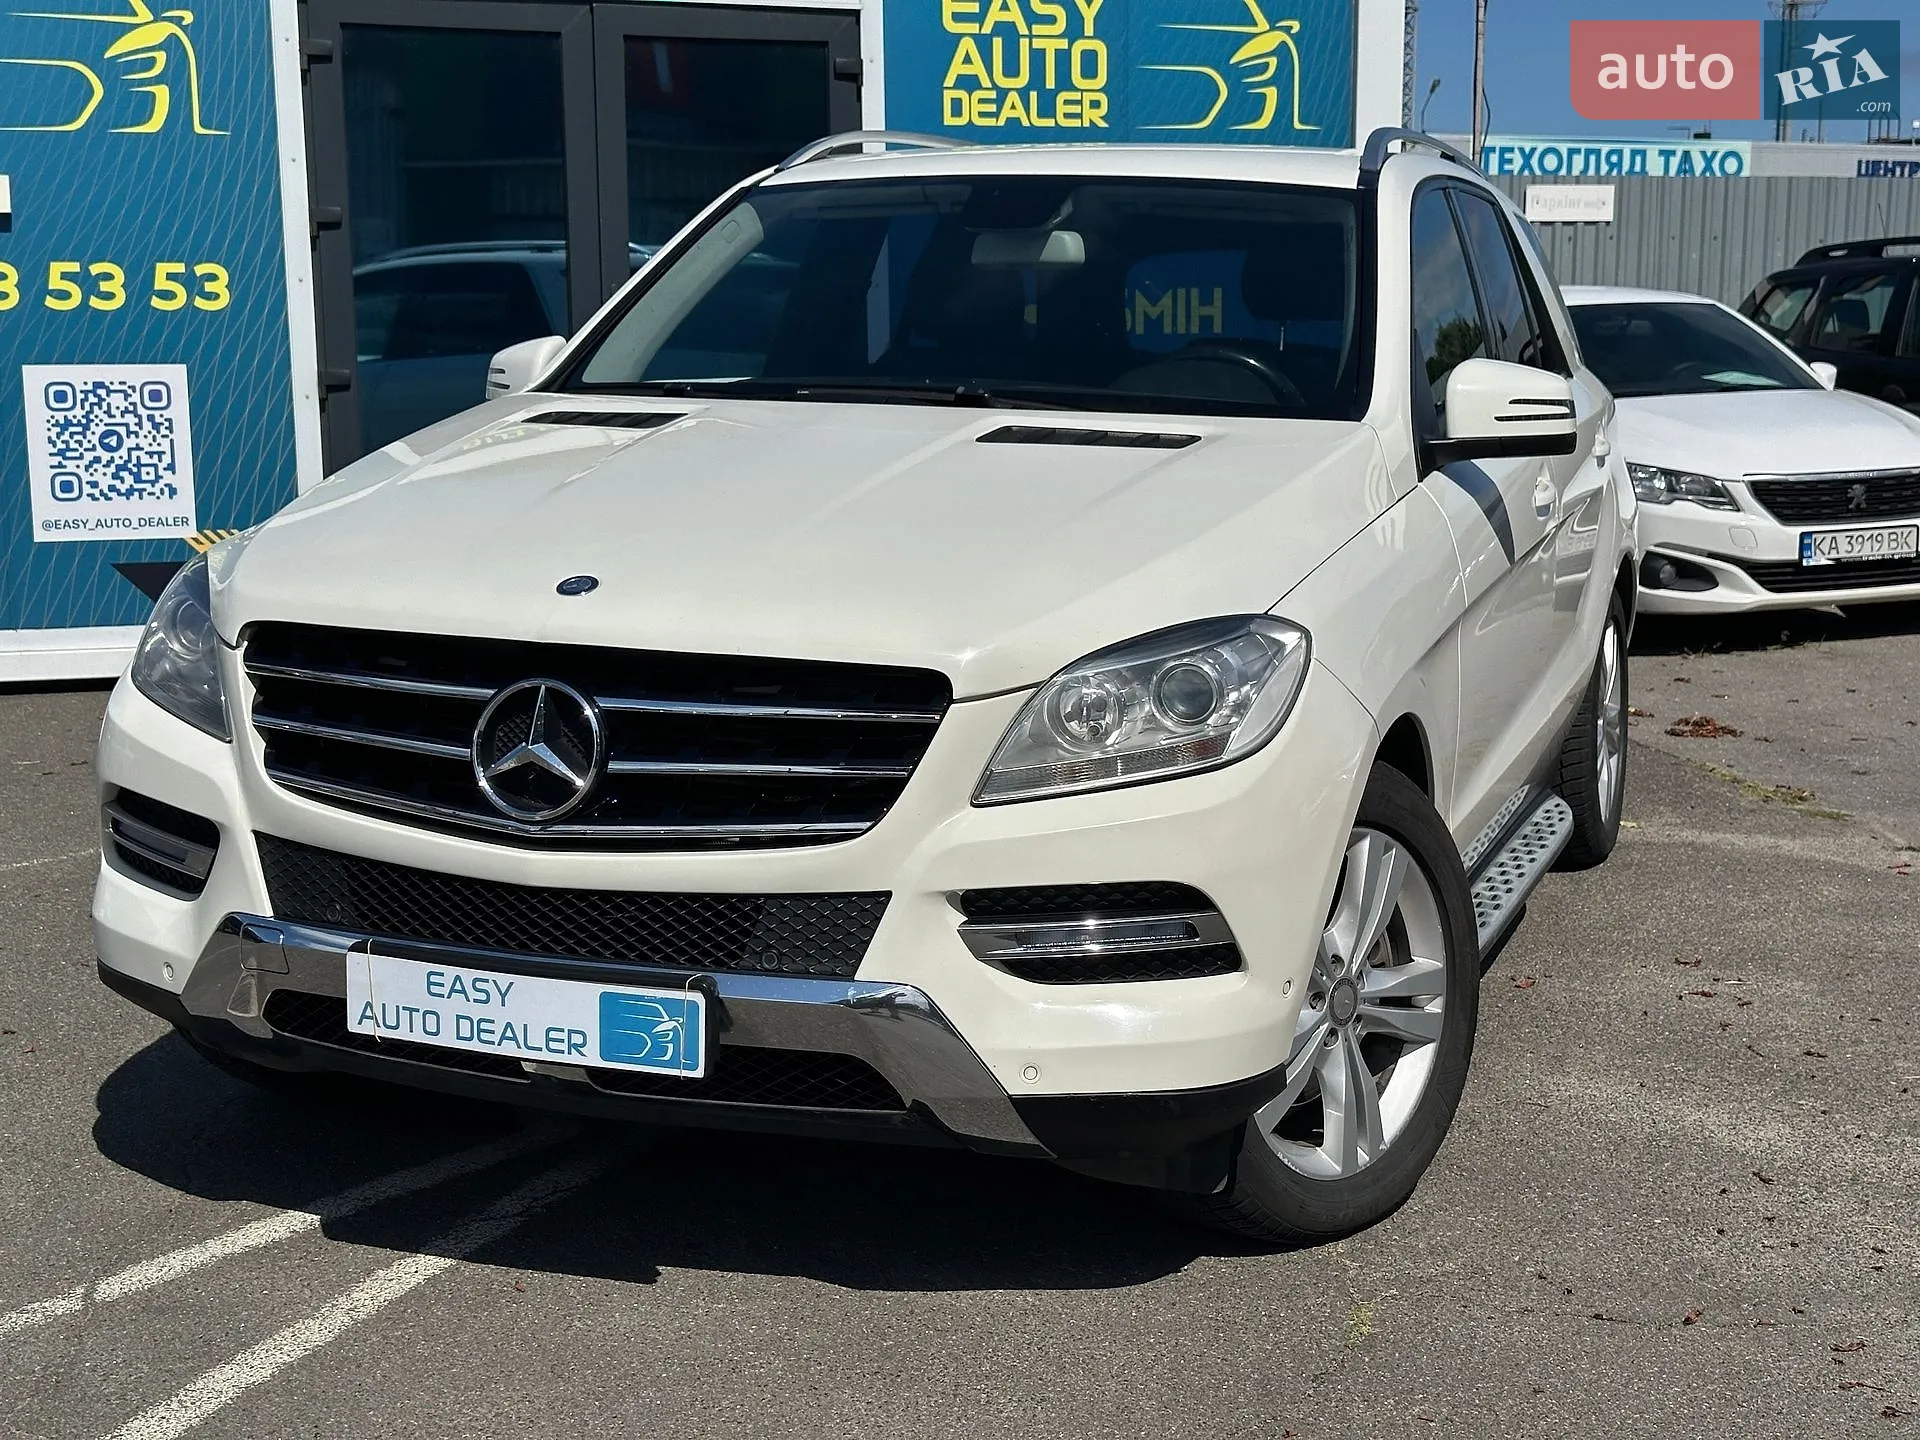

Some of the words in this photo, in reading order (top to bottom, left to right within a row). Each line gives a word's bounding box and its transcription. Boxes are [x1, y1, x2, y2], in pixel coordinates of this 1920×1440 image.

[942, 0, 1103, 37] EASY
[943, 36, 1107, 90] AUTO
[943, 89, 1109, 128] DEALER
[1658, 150, 1744, 177] ТАХО
[44, 261, 126, 311] 53
[150, 262, 231, 312] 53
[41, 516, 190, 532] @EASY_AUTO_DEALER
[1844, 533, 1884, 554] 3919
[1887, 529, 1913, 551] BK
[426, 970, 514, 1007] EASY
[357, 1000, 442, 1037] AUTO
[455, 1014, 588, 1057] DEALER
